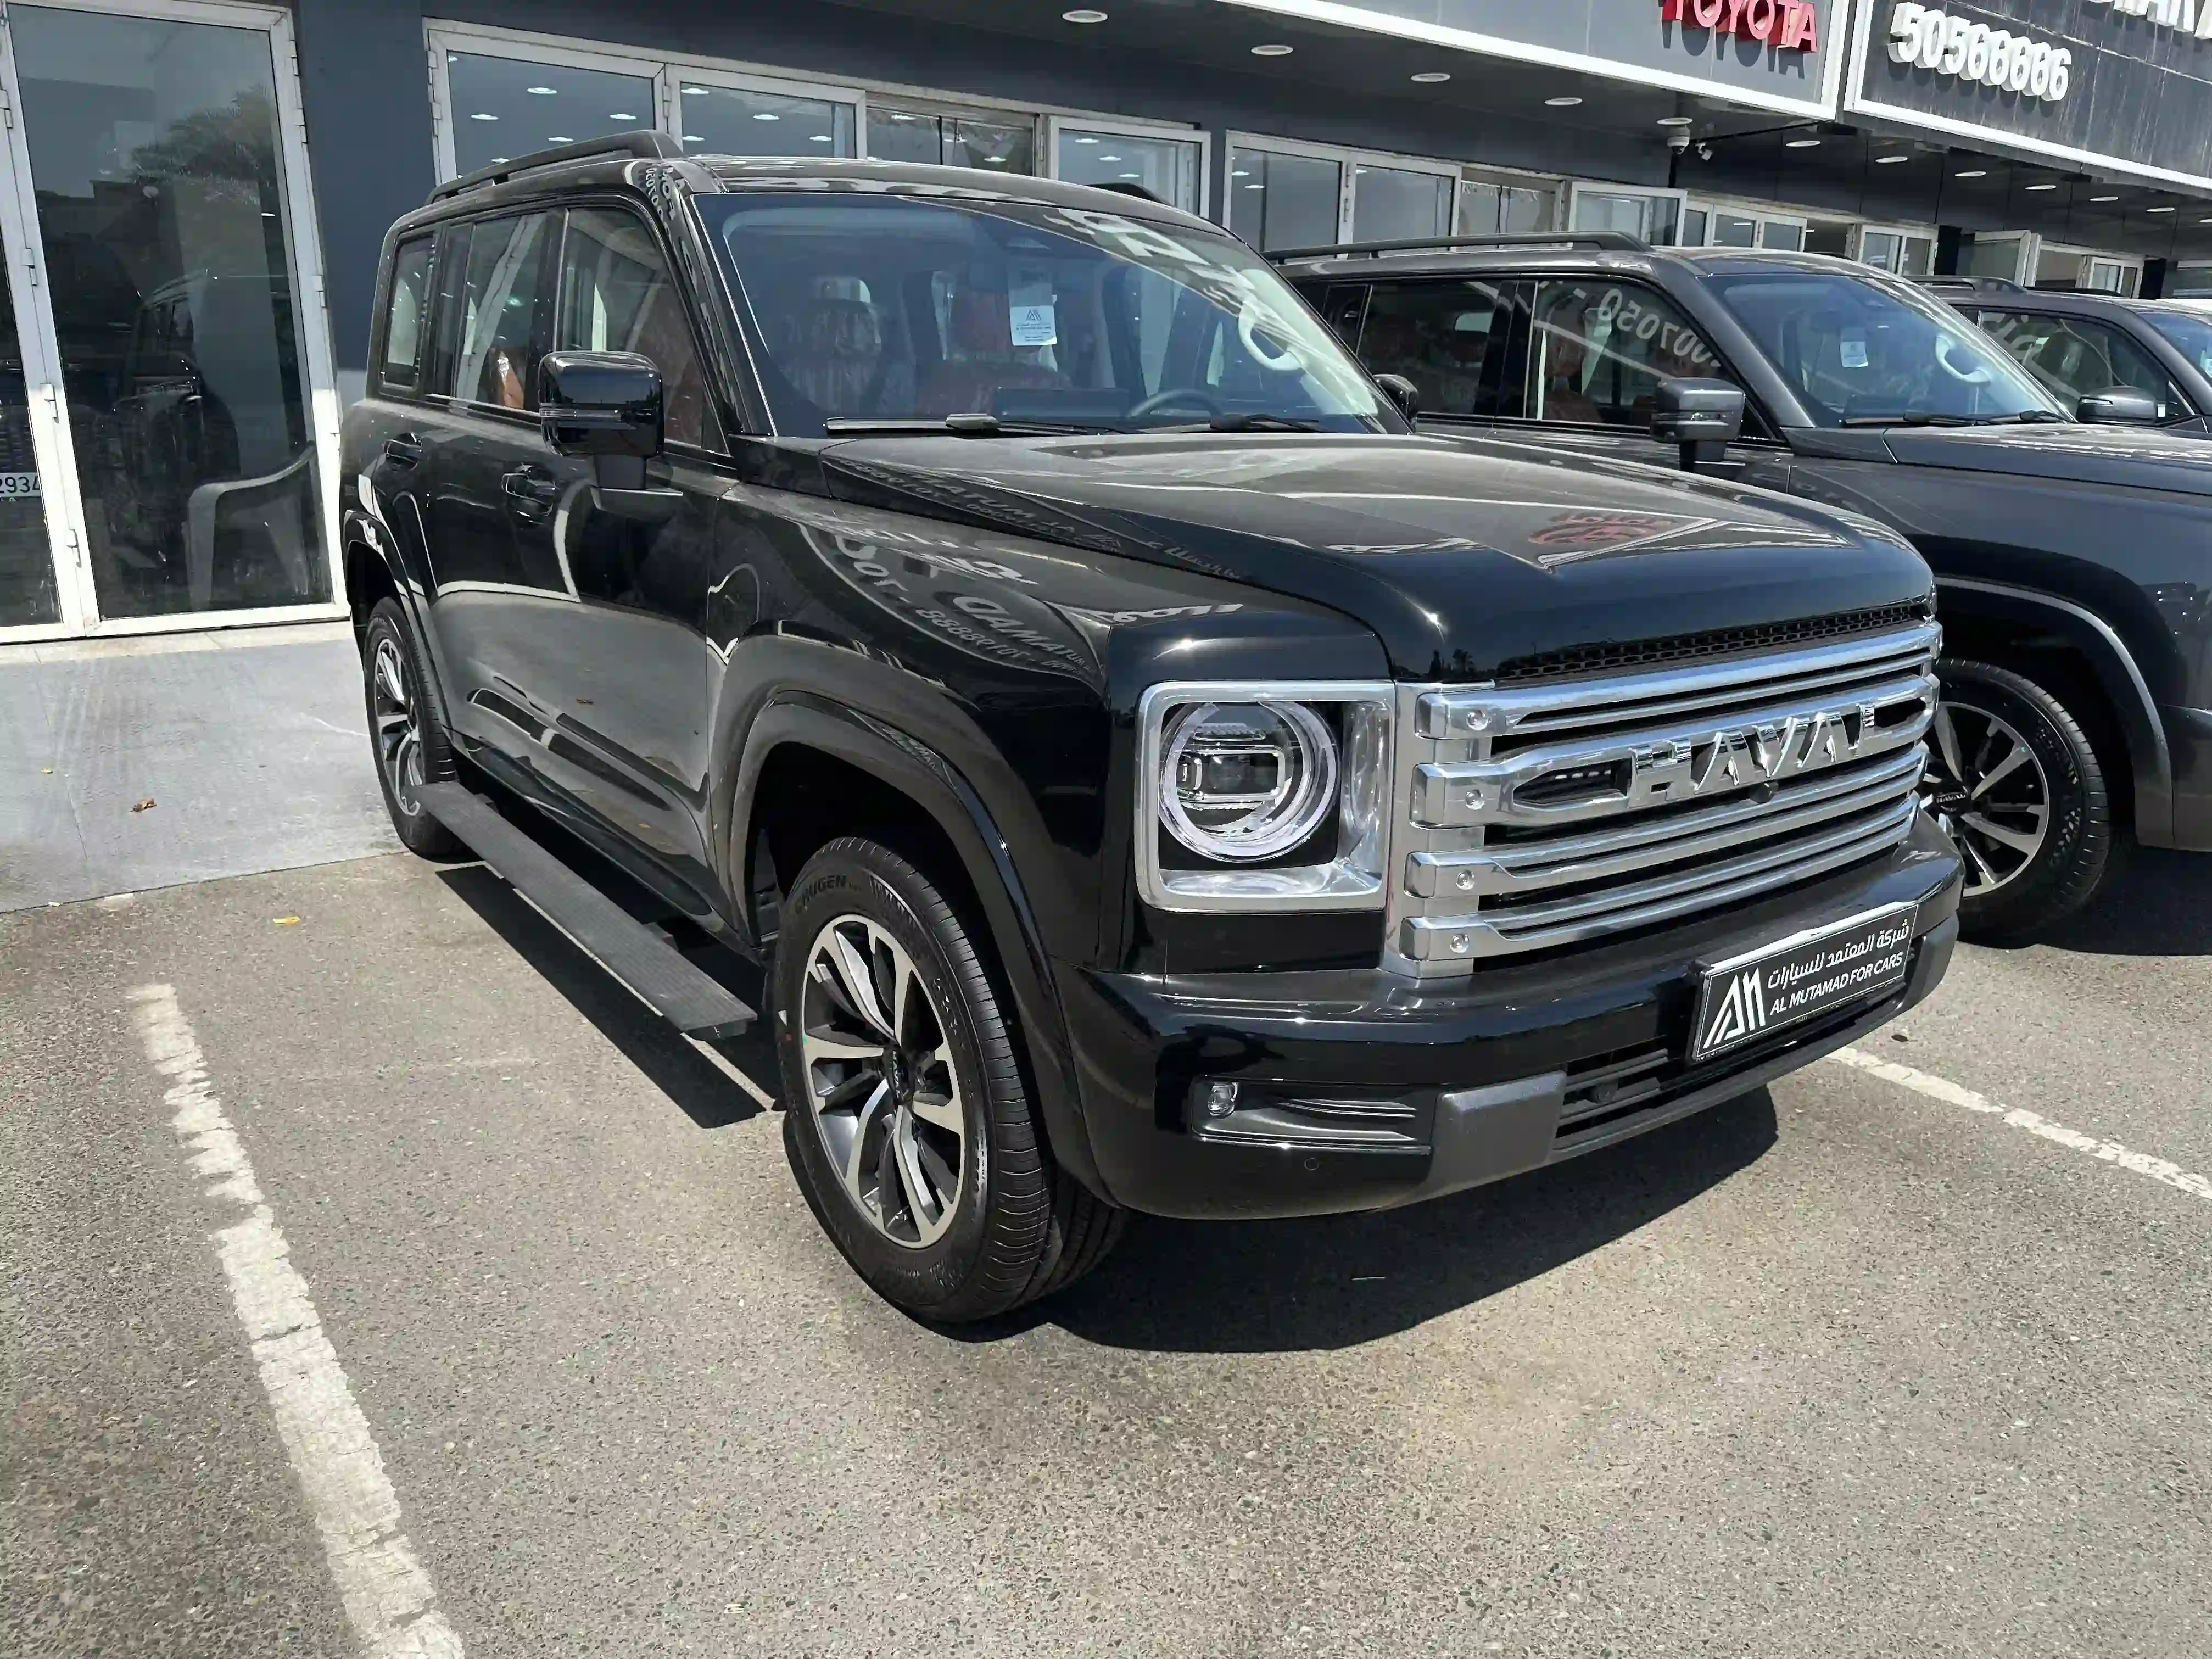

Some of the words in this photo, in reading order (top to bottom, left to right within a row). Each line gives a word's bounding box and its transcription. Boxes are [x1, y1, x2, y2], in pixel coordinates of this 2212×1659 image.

[1826, 933, 1875, 968] المعتمد
[1876, 919, 1909, 949] شركة
[1768, 952, 1825, 990] للسيارات
[1770, 997, 1788, 1016] AL
[1789, 973, 1849, 1008] MUTAMAD
[1850, 963, 1874, 985] FOR
[1874, 951, 1904, 975] CARS
